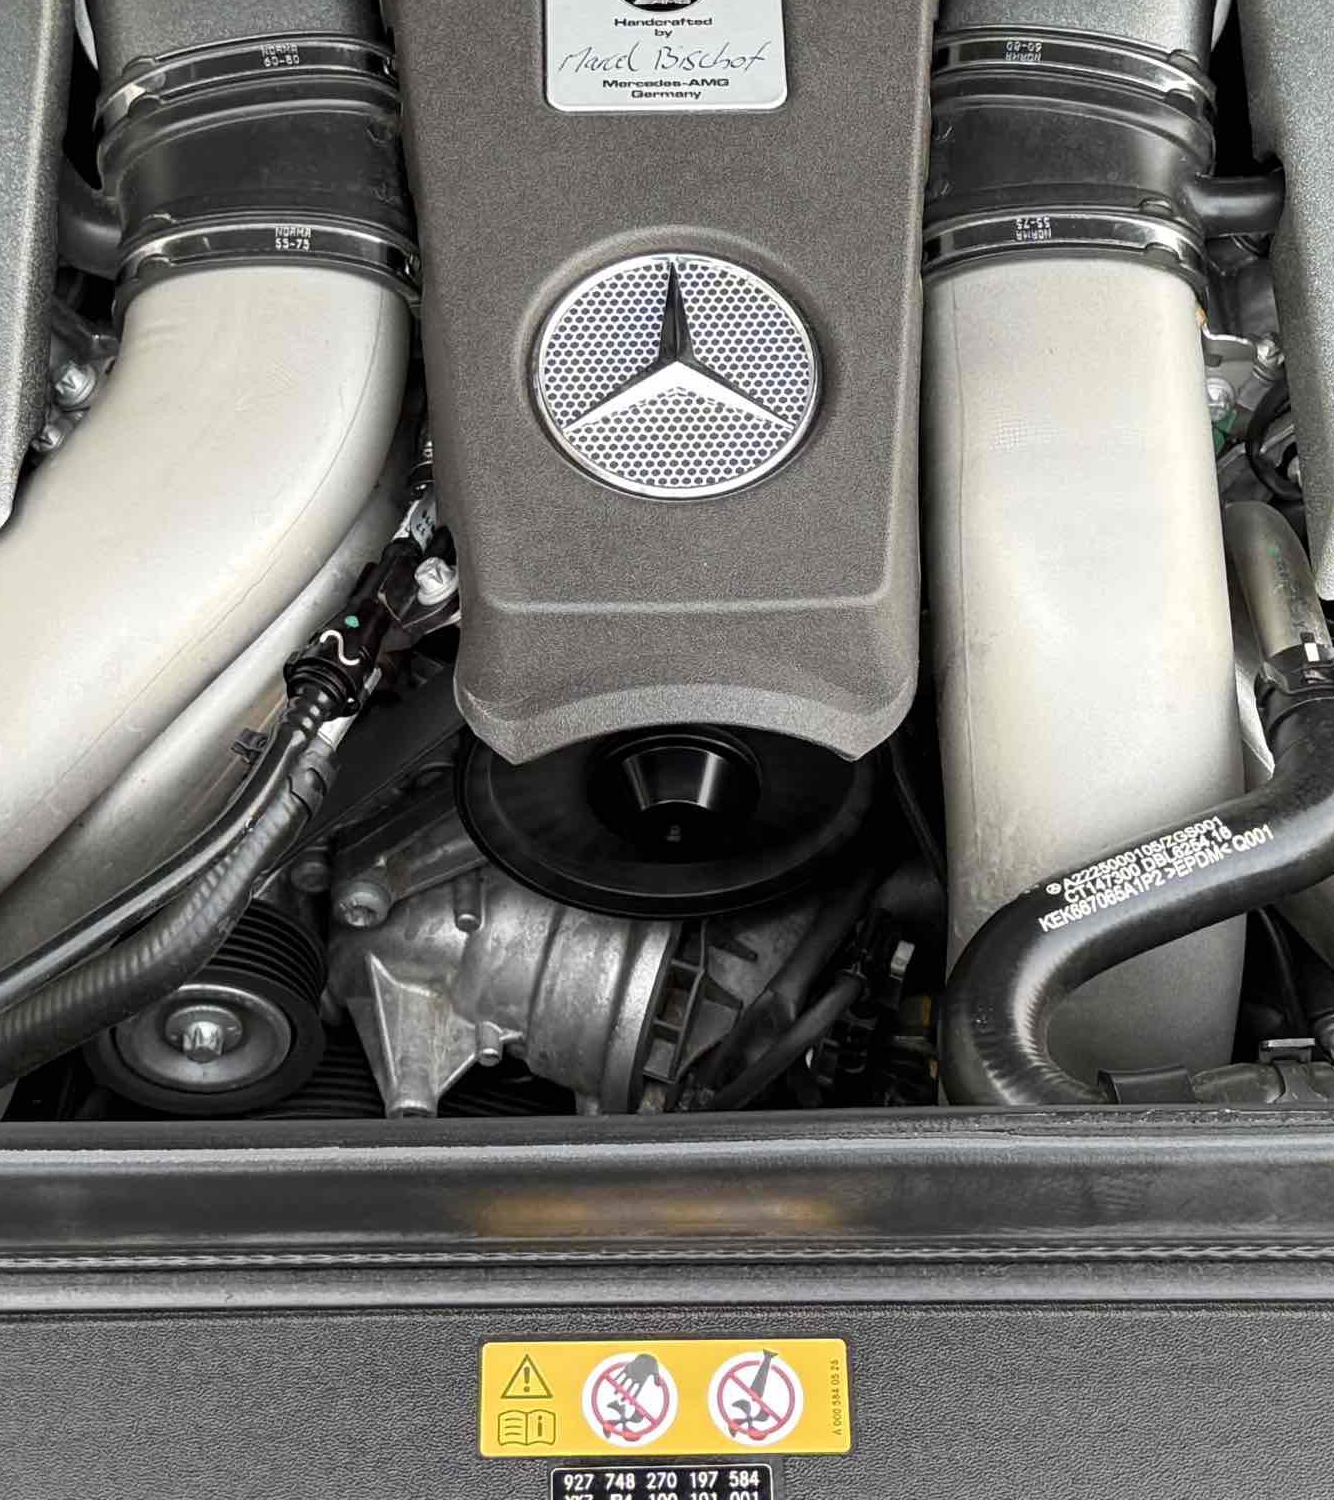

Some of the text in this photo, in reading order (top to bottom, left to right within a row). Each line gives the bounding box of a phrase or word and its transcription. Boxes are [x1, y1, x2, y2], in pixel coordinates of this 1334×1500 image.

[614, 17, 713, 27] Handcrafted
[654, 29, 673, 39] by
[603, 78, 729, 88] Mercedes-AMG
[631, 89, 702, 100] Germany
[275, 238, 310, 251] 55-75
[1064, 863, 1142, 904] CT147300
[563, 1470, 760, 1492] 927 748 270 197 584
